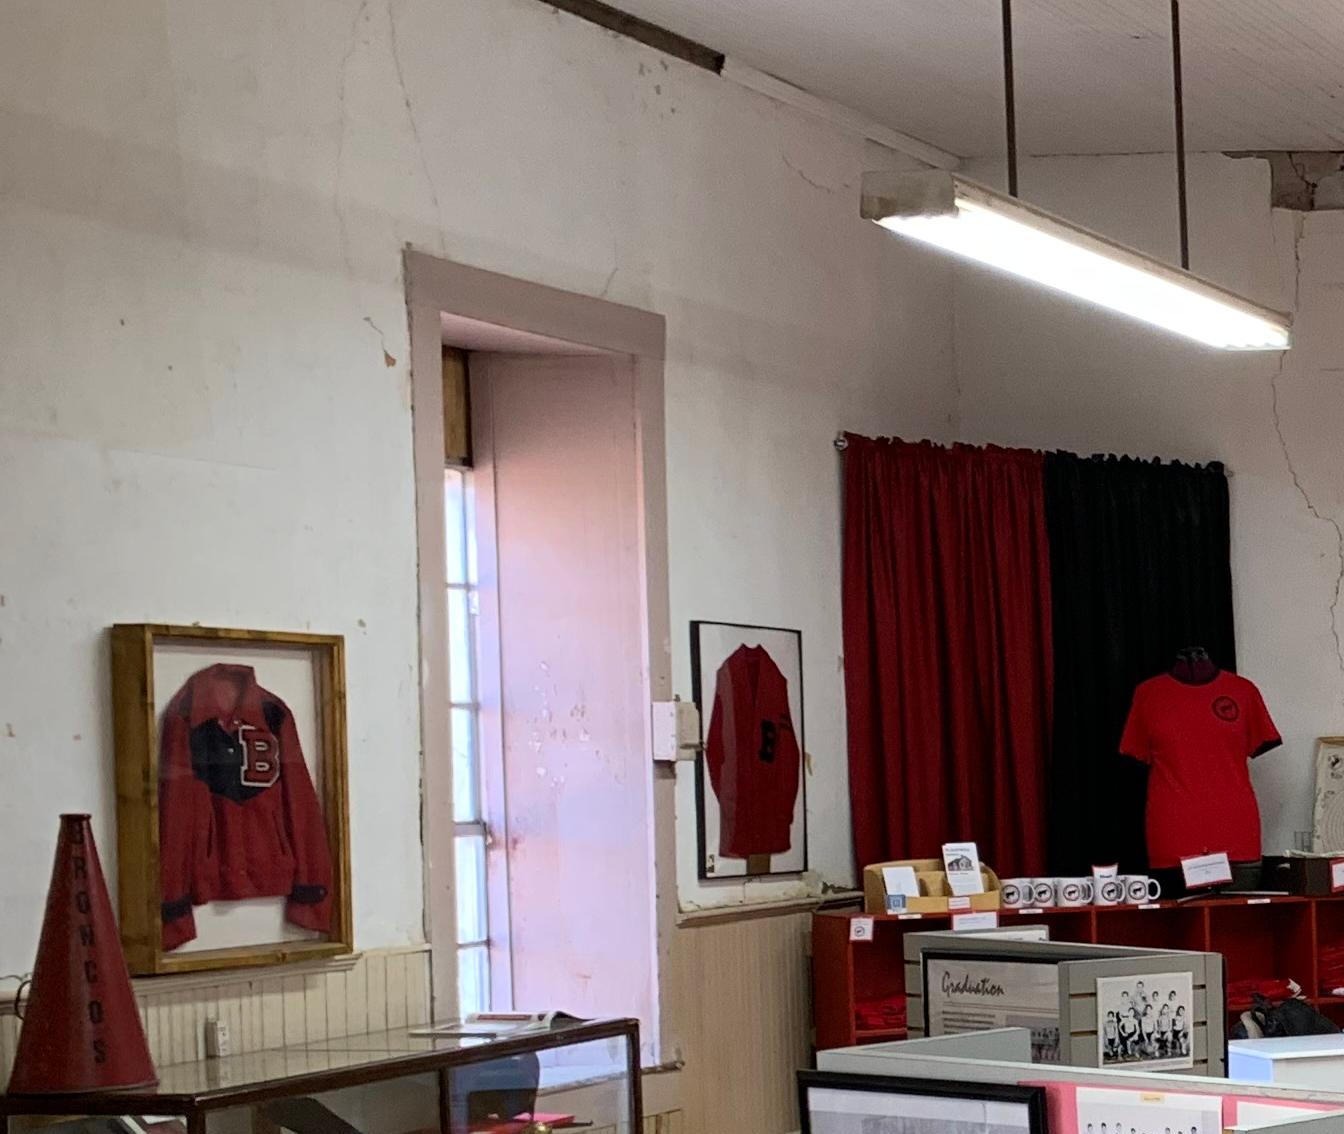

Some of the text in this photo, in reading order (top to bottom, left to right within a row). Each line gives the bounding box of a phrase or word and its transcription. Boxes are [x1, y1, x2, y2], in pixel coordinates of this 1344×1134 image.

[239, 725, 281, 787] B
[71, 819, 106, 1065] BRONCOS
[941, 971, 1005, 996] Graduation
